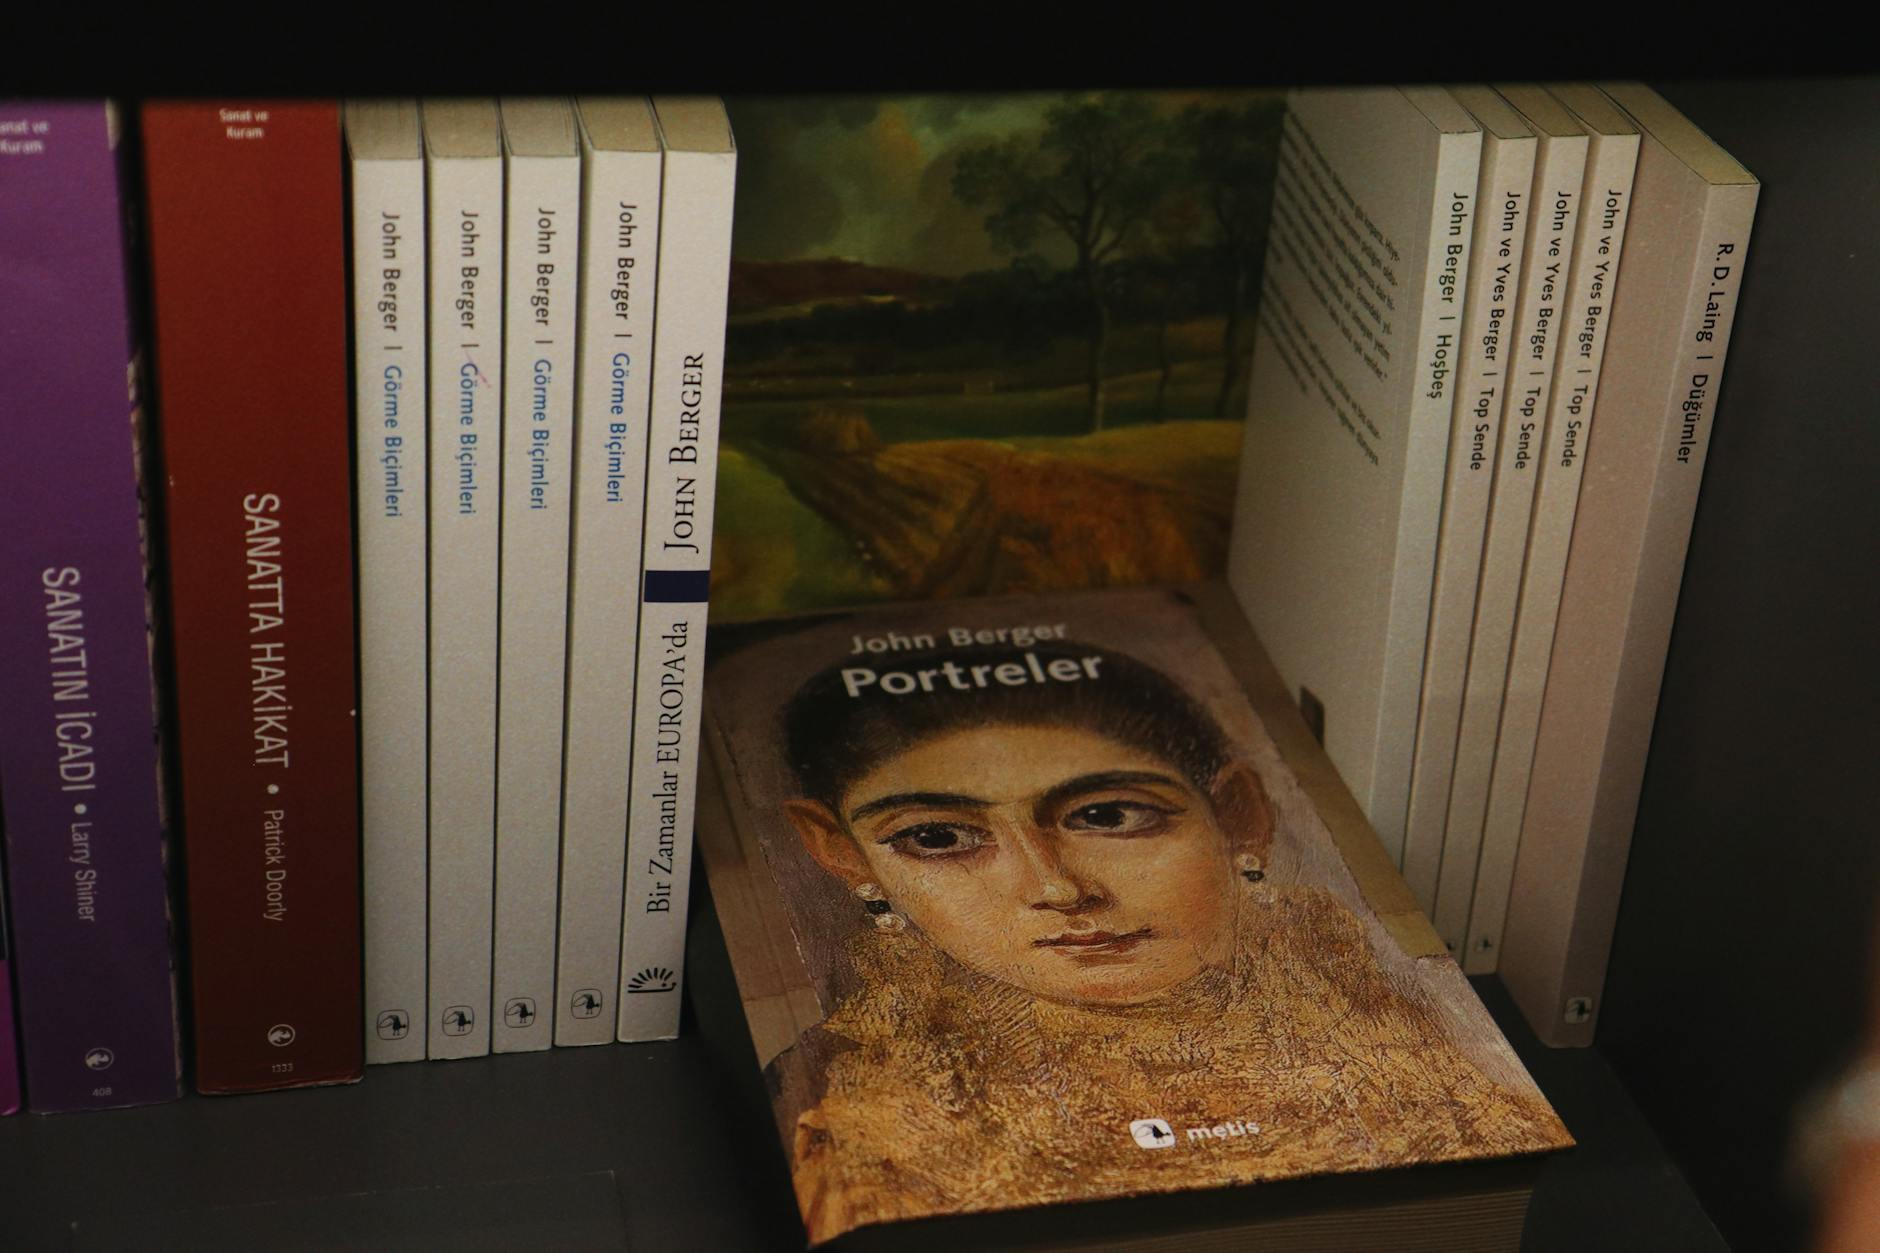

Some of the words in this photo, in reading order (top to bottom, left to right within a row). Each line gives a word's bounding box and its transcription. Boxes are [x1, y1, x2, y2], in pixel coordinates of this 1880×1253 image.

[0, 119, 29, 135] anat
[32, 120, 50, 135] ve
[219, 108, 251, 122] Sanat
[254, 110, 269, 122] ve
[226, 126, 264, 139] Kuram
[538, 208, 556, 255] John
[619, 202, 637, 248] John
[1448, 192, 1469, 236] John
[1500, 191, 1520, 232] John
[1551, 191, 1571, 231] John
[1602, 189, 1622, 229] John
[382, 211, 402, 258] John
[461, 210, 479, 257] John
[1499, 238, 1511, 257] ve
[1550, 238, 1561, 256] ve
[1599, 236, 1611, 255] ve
[456, 267, 478, 329] Berger
[530, 263, 554, 326] Berger
[611, 257, 635, 320] Berger
[1439, 244, 1462, 304] Berger
[1493, 262, 1511, 302] Yves
[1541, 262, 1561, 301] Yves
[1590, 260, 1611, 300] Yves
[378, 268, 401, 332] Berger
[1483, 308, 1505, 361] Berger
[1530, 307, 1553, 360] Berger
[1579, 305, 1602, 359] Berger
[534, 359, 552, 422] Görme
[610, 353, 630, 415] Görme
[1426, 334, 1453, 399] Hoşbeş
[384, 365, 403, 429] Görme
[460, 363, 478, 425] Görme
[669, 353, 704, 464] BERGER
[1473, 387, 1494, 418] Top
[1520, 386, 1540, 417] Top
[1567, 385, 1588, 416] Top
[1677, 374, 1708, 463] Düğümler
[604, 423, 627, 502] Biçimleri
[1470, 423, 1490, 471] Sende
[1515, 422, 1535, 470] Sende
[1561, 420, 1582, 468] Sende
[380, 437, 404, 517] Biçimleri
[455, 434, 478, 515] Biçimleri
[527, 429, 549, 510] Biçimleri
[664, 477, 699, 554] JOHN
[243, 494, 284, 633] SANATTA
[43, 567, 88, 701] SANATIN
[850, 632, 935, 655] John
[948, 623, 1067, 648] Berger
[657, 621, 688, 764] EUROPA’da
[841, 653, 1102, 698] Portreler
[251, 643, 293, 768] HAKİKAT
[55, 711, 97, 791] İCADI
[69, 822, 93, 865] Larry
[264, 809, 285, 865] Patrick
[648, 771, 679, 875] Zamanlar
[74, 870, 96, 922] Shiner
[263, 871, 286, 922] Doorly
[647, 886, 671, 915] Bir
[92, 1086, 112, 1097] 408
[271, 1063, 294, 1073] 1333
[1187, 1120, 1261, 1142] metis
